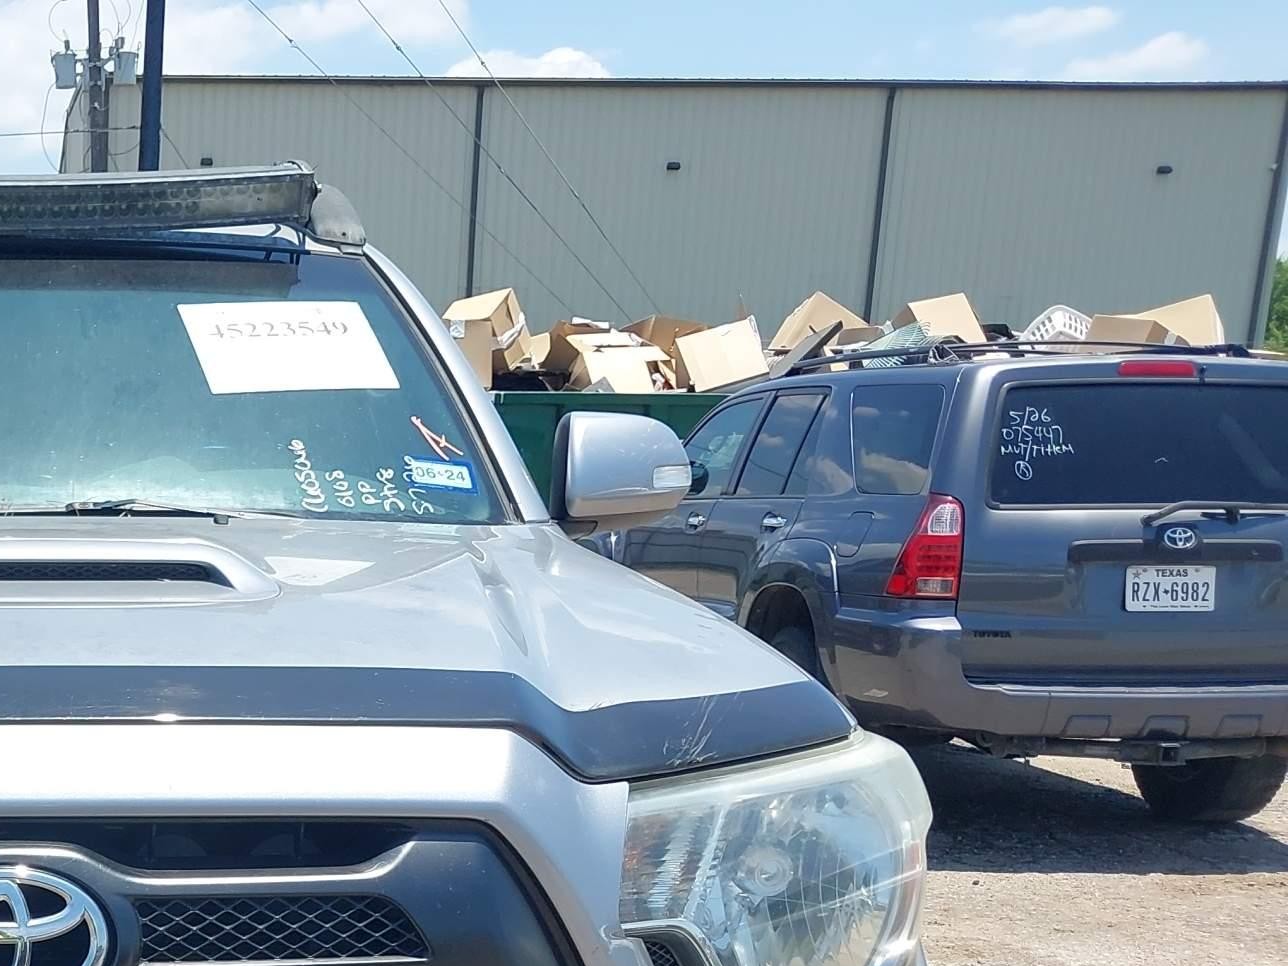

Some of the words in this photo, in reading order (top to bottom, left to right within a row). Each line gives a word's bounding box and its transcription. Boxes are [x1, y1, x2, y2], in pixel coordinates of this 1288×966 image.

[209, 320, 349, 339] 45223549
[1001, 425, 1062, 444] 075447
[1154, 568, 1189, 578] TEXAS
[1131, 581, 1161, 602] RZX
[1170, 581, 1210, 602] 6982
